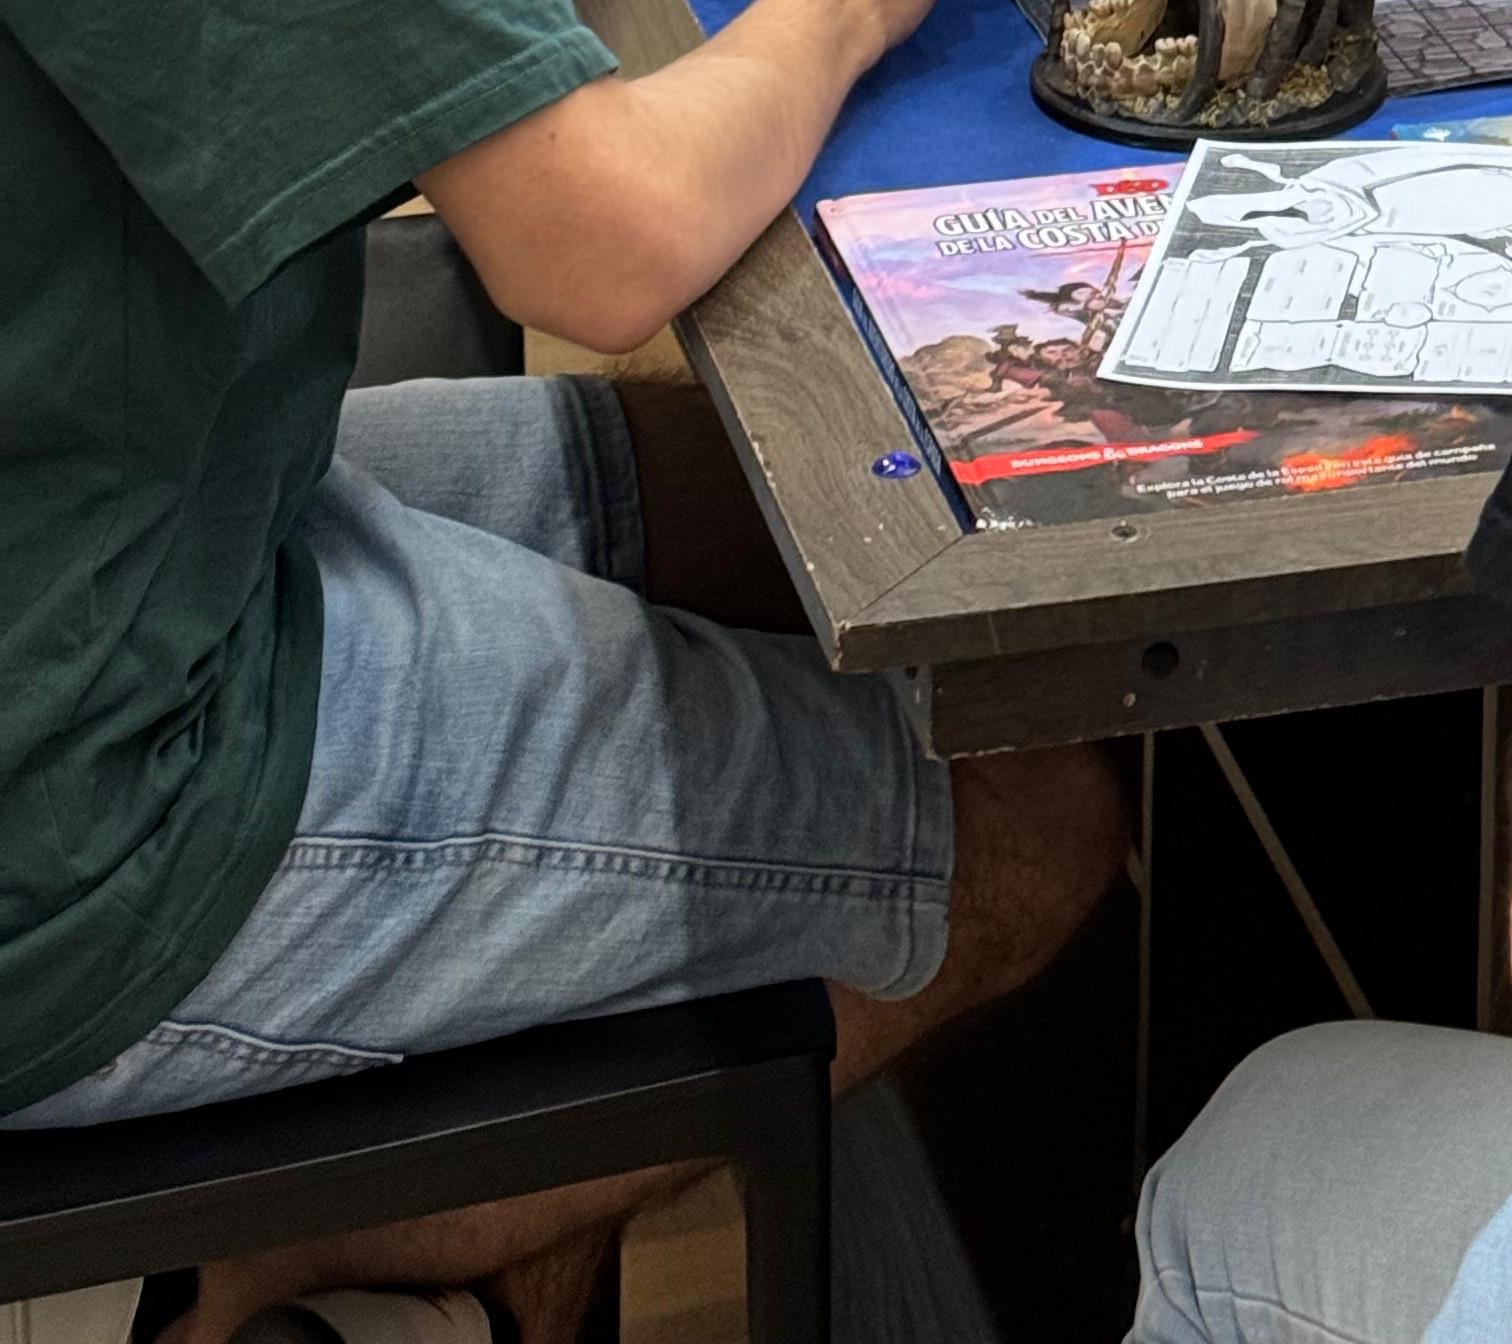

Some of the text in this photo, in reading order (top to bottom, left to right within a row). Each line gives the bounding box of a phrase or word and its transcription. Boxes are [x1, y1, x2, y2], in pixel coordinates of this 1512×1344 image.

[932, 207, 1030, 238] GUÍA
[1033, 207, 1088, 226] DEL
[937, 220, 1134, 256] DE LA COSTA
